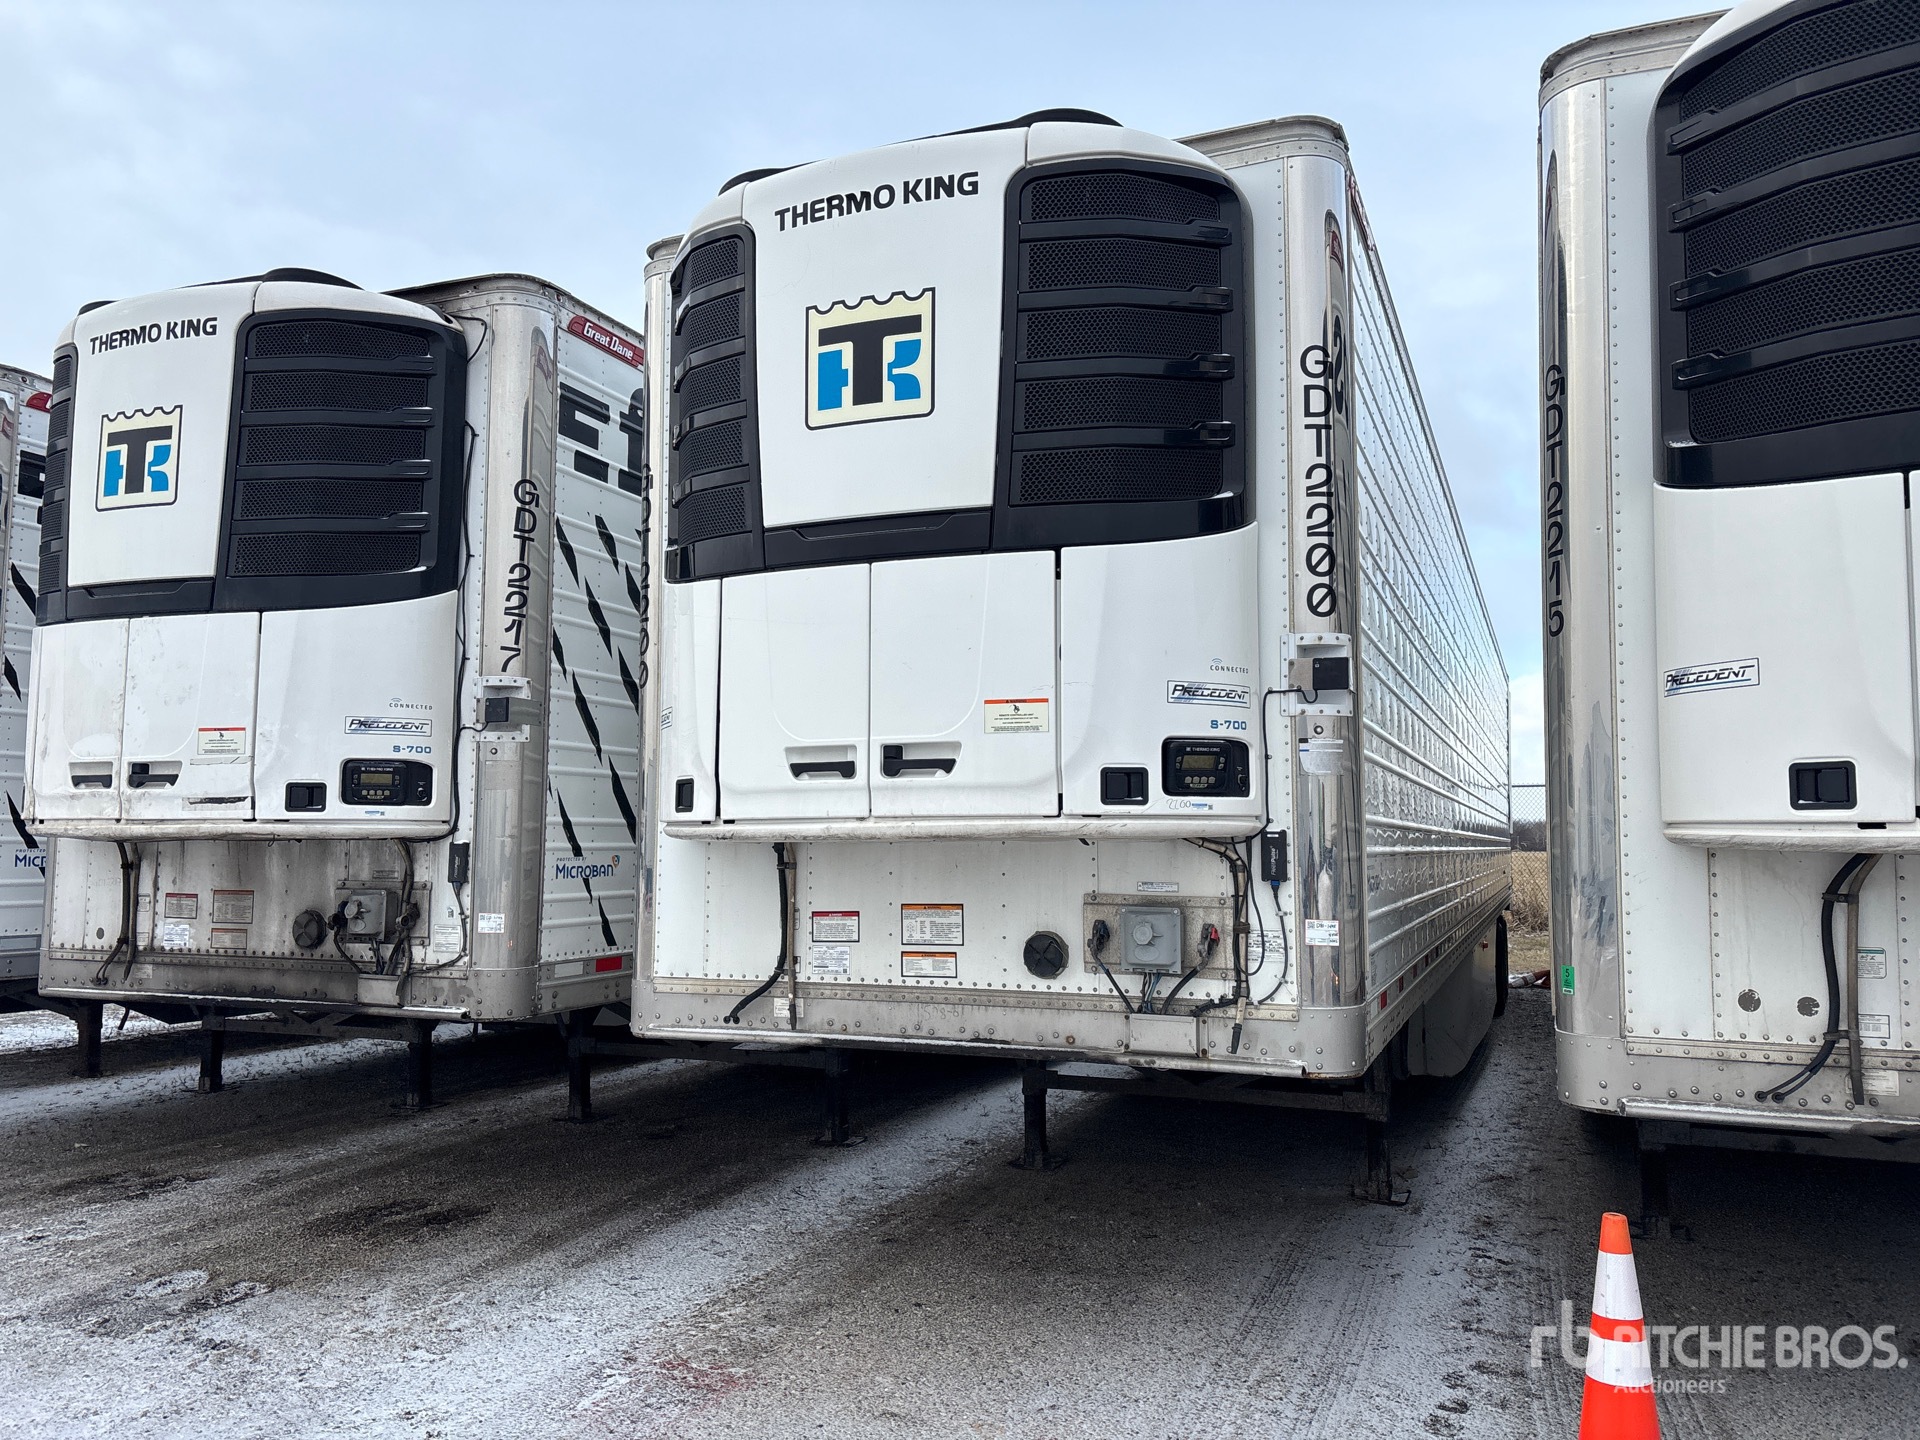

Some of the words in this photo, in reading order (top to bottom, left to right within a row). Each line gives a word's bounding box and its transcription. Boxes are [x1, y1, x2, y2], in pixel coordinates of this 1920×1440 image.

[774, 183, 896, 232] THERMO
[903, 171, 979, 205] KING
[89, 323, 162, 355] THERMO
[166, 317, 218, 340] KING
[583, 321, 611, 349] Great
[610, 336, 644, 361] Dane
[1300, 345, 1337, 618] GDT2200
[1545, 364, 1566, 638] GDT2215
[500, 478, 540, 673] GDT2217
[1209, 664, 1249, 674] CONNECTED
[1665, 664, 1756, 689] PRECEDENT
[1171, 684, 1249, 700] PRECEDENT
[388, 702, 433, 711] CONNECTED
[349, 718, 430, 731] PRECEDENT
[1210, 719, 1247, 731] S-700
[392, 745, 432, 754] S-700
[555, 863, 614, 879] MICROBAN
[1565, 968, 1570, 978] 5
